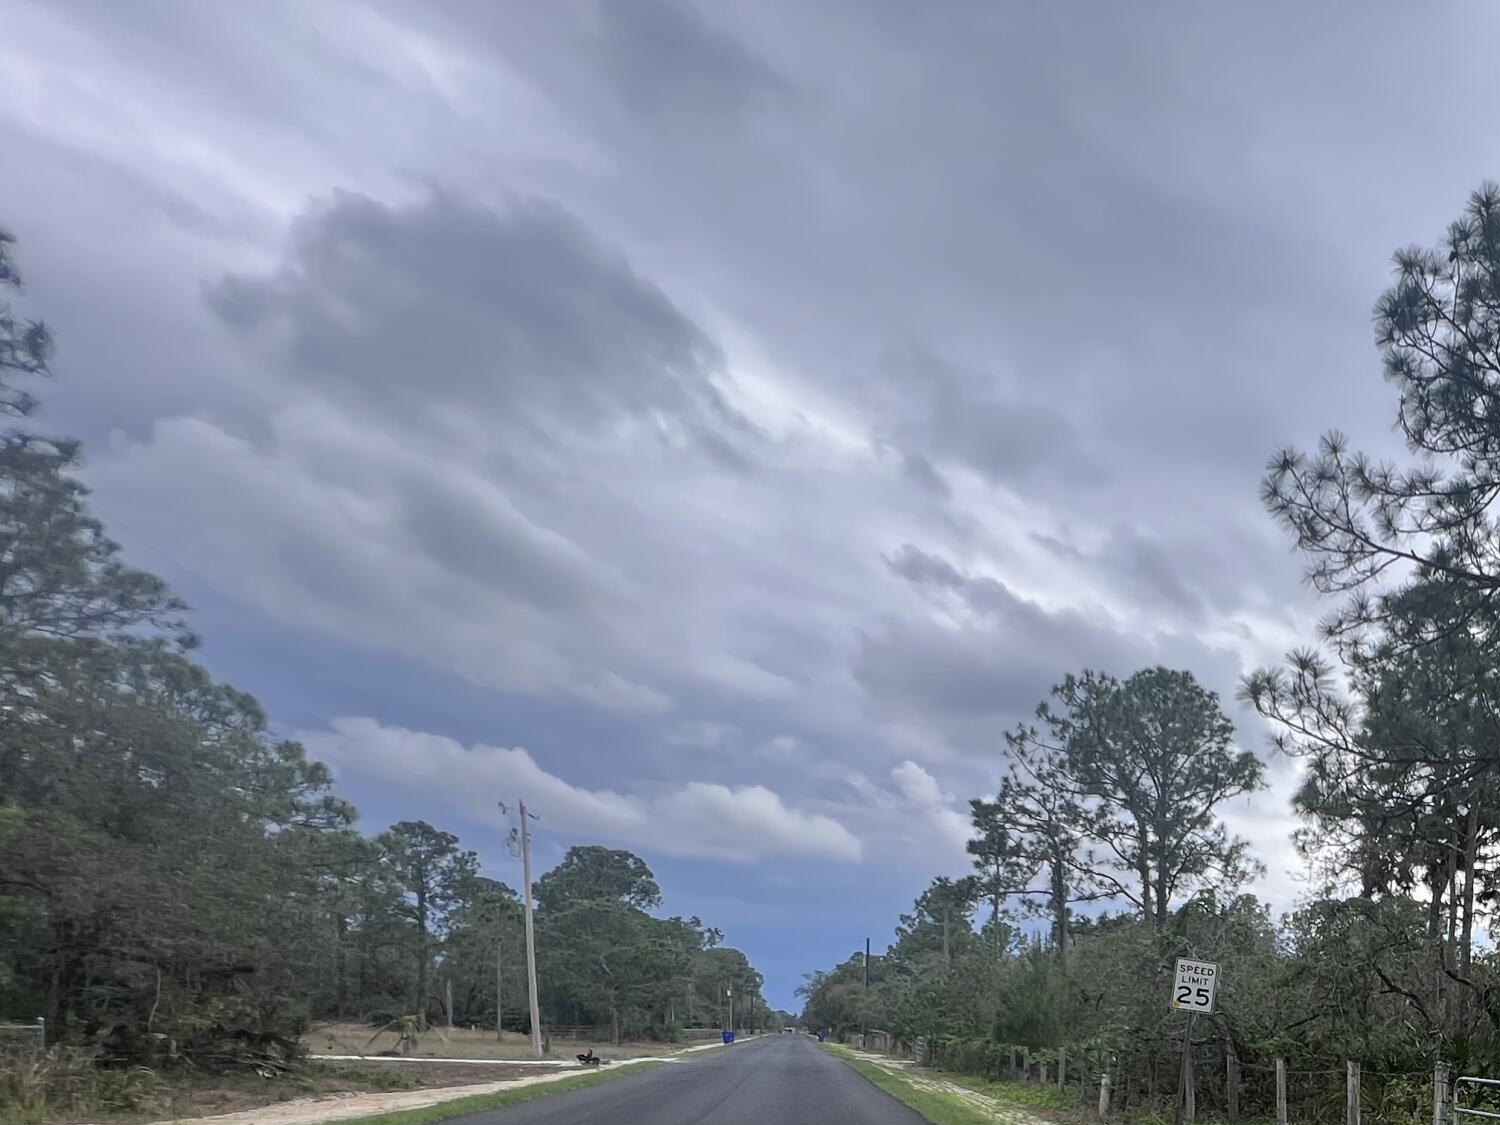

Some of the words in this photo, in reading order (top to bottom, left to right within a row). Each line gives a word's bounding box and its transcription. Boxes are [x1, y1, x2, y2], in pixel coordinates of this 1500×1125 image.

[1180, 965, 1214, 976] SPEED
[1182, 975, 1209, 985] LIMIT
[1177, 986, 1209, 1006] 25
